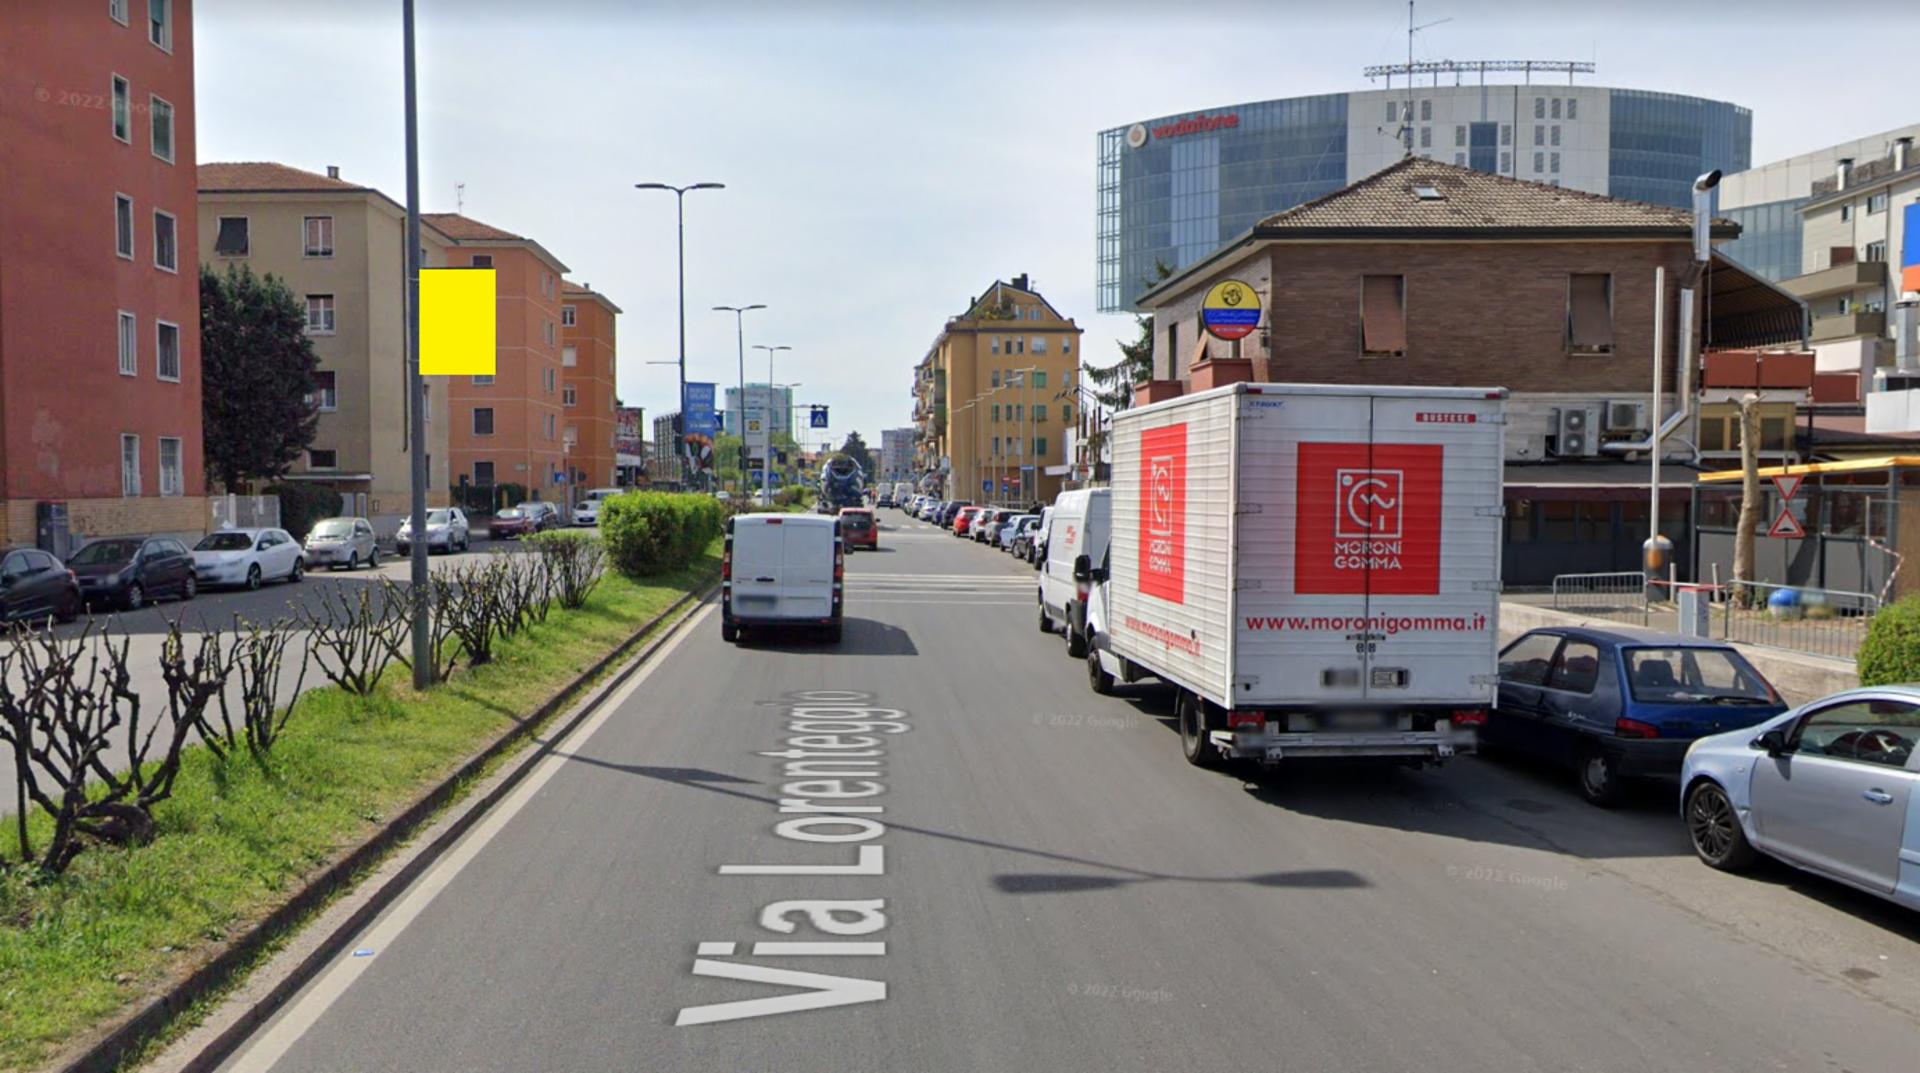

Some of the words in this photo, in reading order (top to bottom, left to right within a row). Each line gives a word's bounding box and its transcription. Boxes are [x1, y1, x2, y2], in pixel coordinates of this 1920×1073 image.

[1152, 112, 1239, 139] vodafone
[1334, 556, 1402, 569] GOMMA
[1246, 612, 1486, 634] www.moronigomma.it
